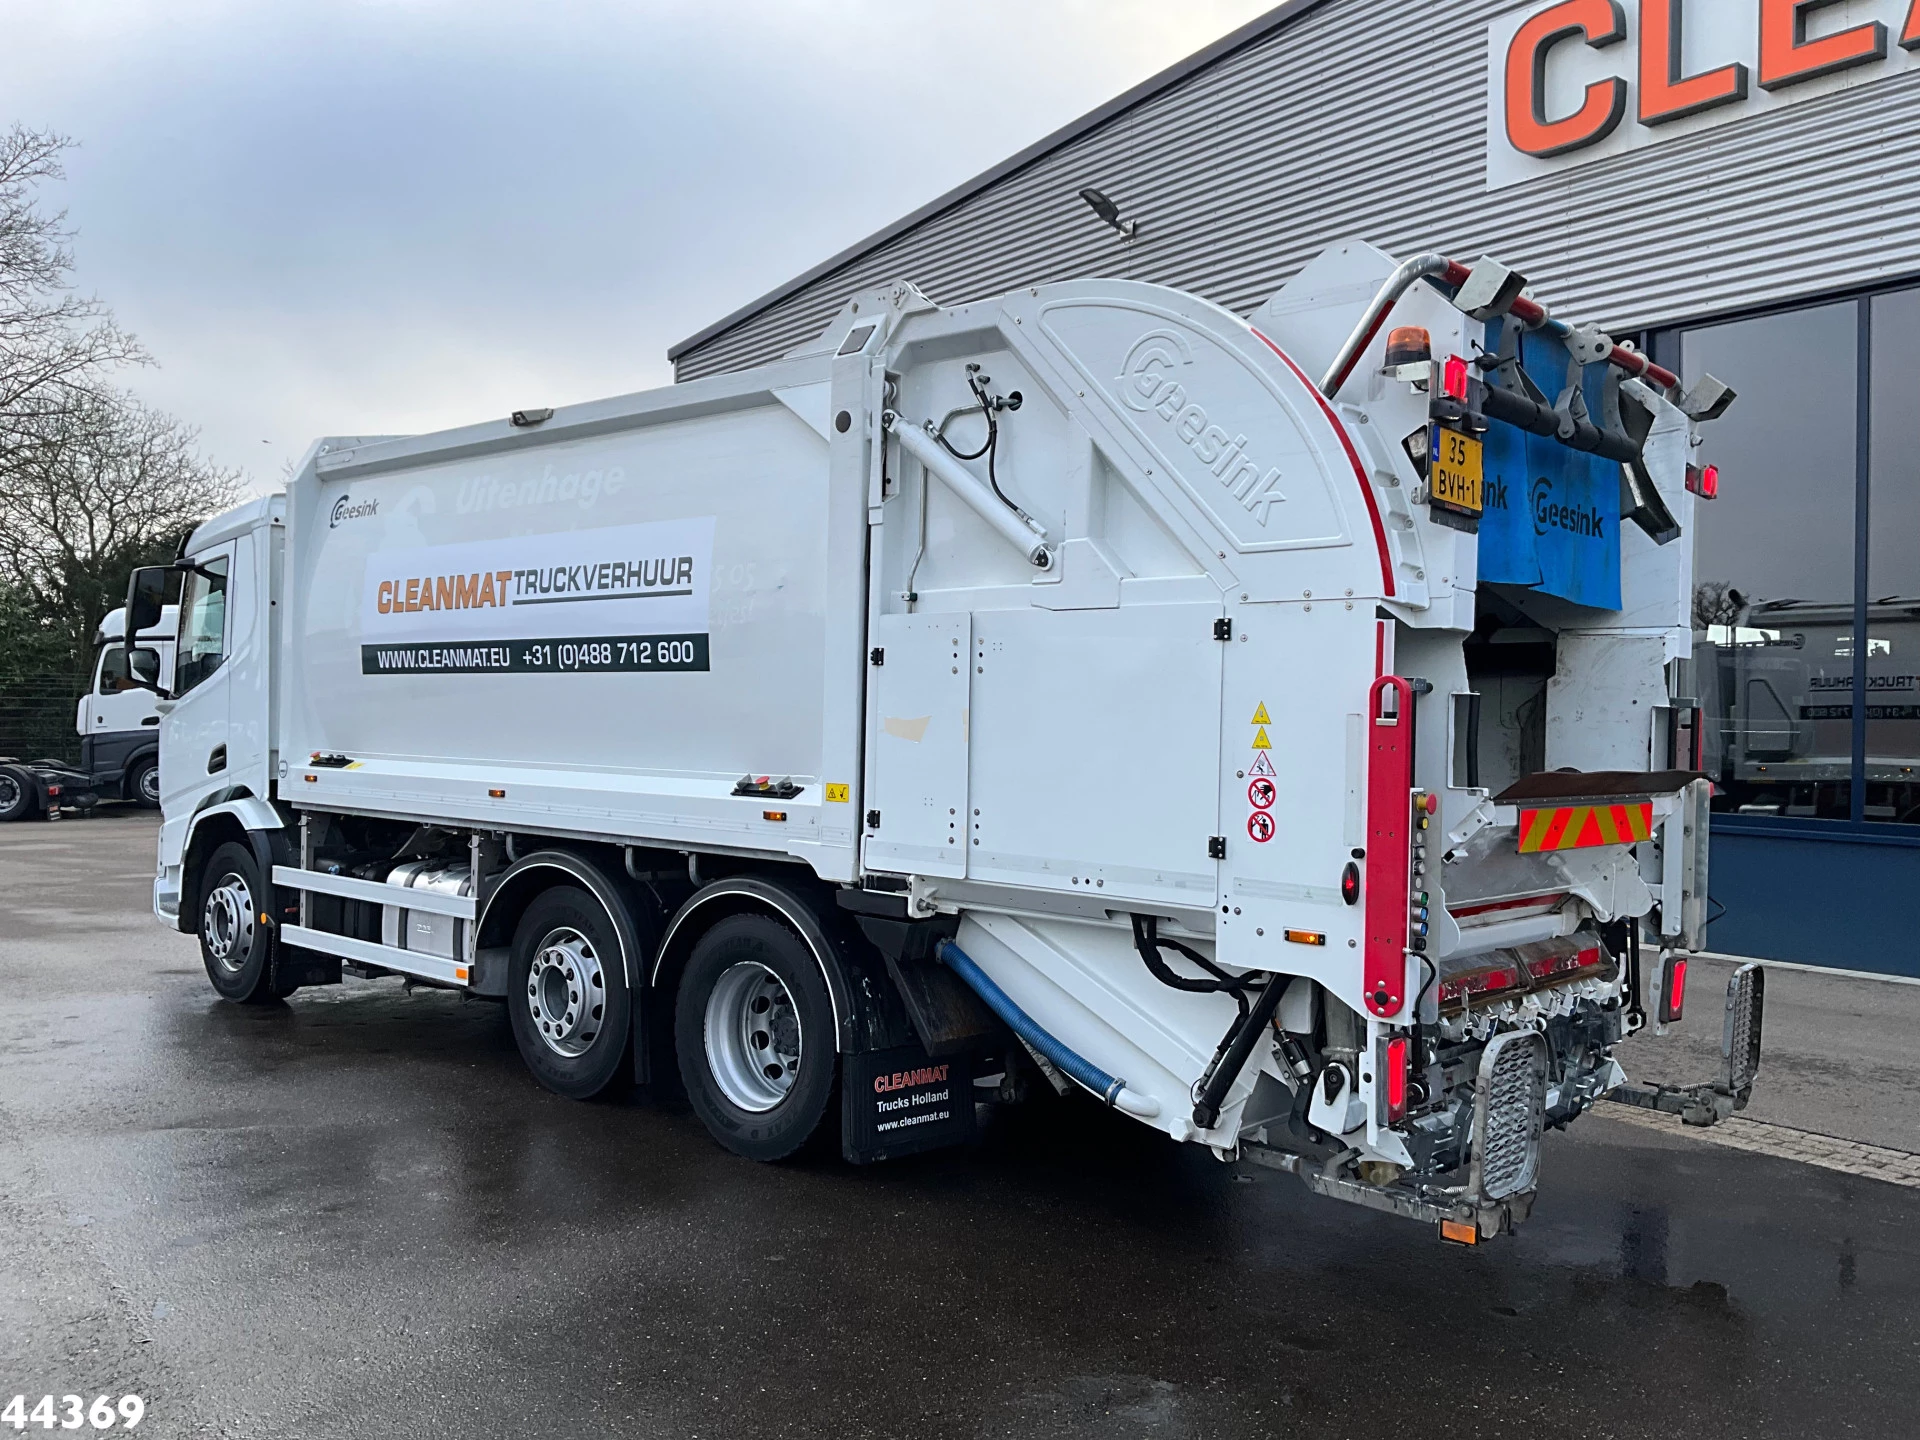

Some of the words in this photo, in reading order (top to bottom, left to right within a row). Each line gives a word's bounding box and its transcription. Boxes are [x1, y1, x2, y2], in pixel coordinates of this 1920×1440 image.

[1505, 0, 1920, 158] CLE
[1114, 328, 1287, 527] Geesink
[1432, 446, 1439, 458] NL
[1449, 436, 1466, 466] 35
[1438, 468, 1475, 505] BVH-1
[330, 494, 380, 529] Geesink
[1531, 477, 1604, 538] Geesink
[377, 570, 513, 615] CLEANMAT
[513, 556, 693, 596] TRUCKVERHUUR
[377, 647, 511, 669] WWW.CLEANMAT.EU
[522, 644, 552, 666] +31
[557, 642, 612, 670] (0)488
[616, 641, 652, 665] 712
[657, 640, 694, 664] 600
[874, 1064, 949, 1093] CLEANMAT
[877, 1097, 910, 1113] Trucks
[911, 1089, 949, 1106] Holland
[877, 1110, 950, 1132] www.cleanmat.eu
